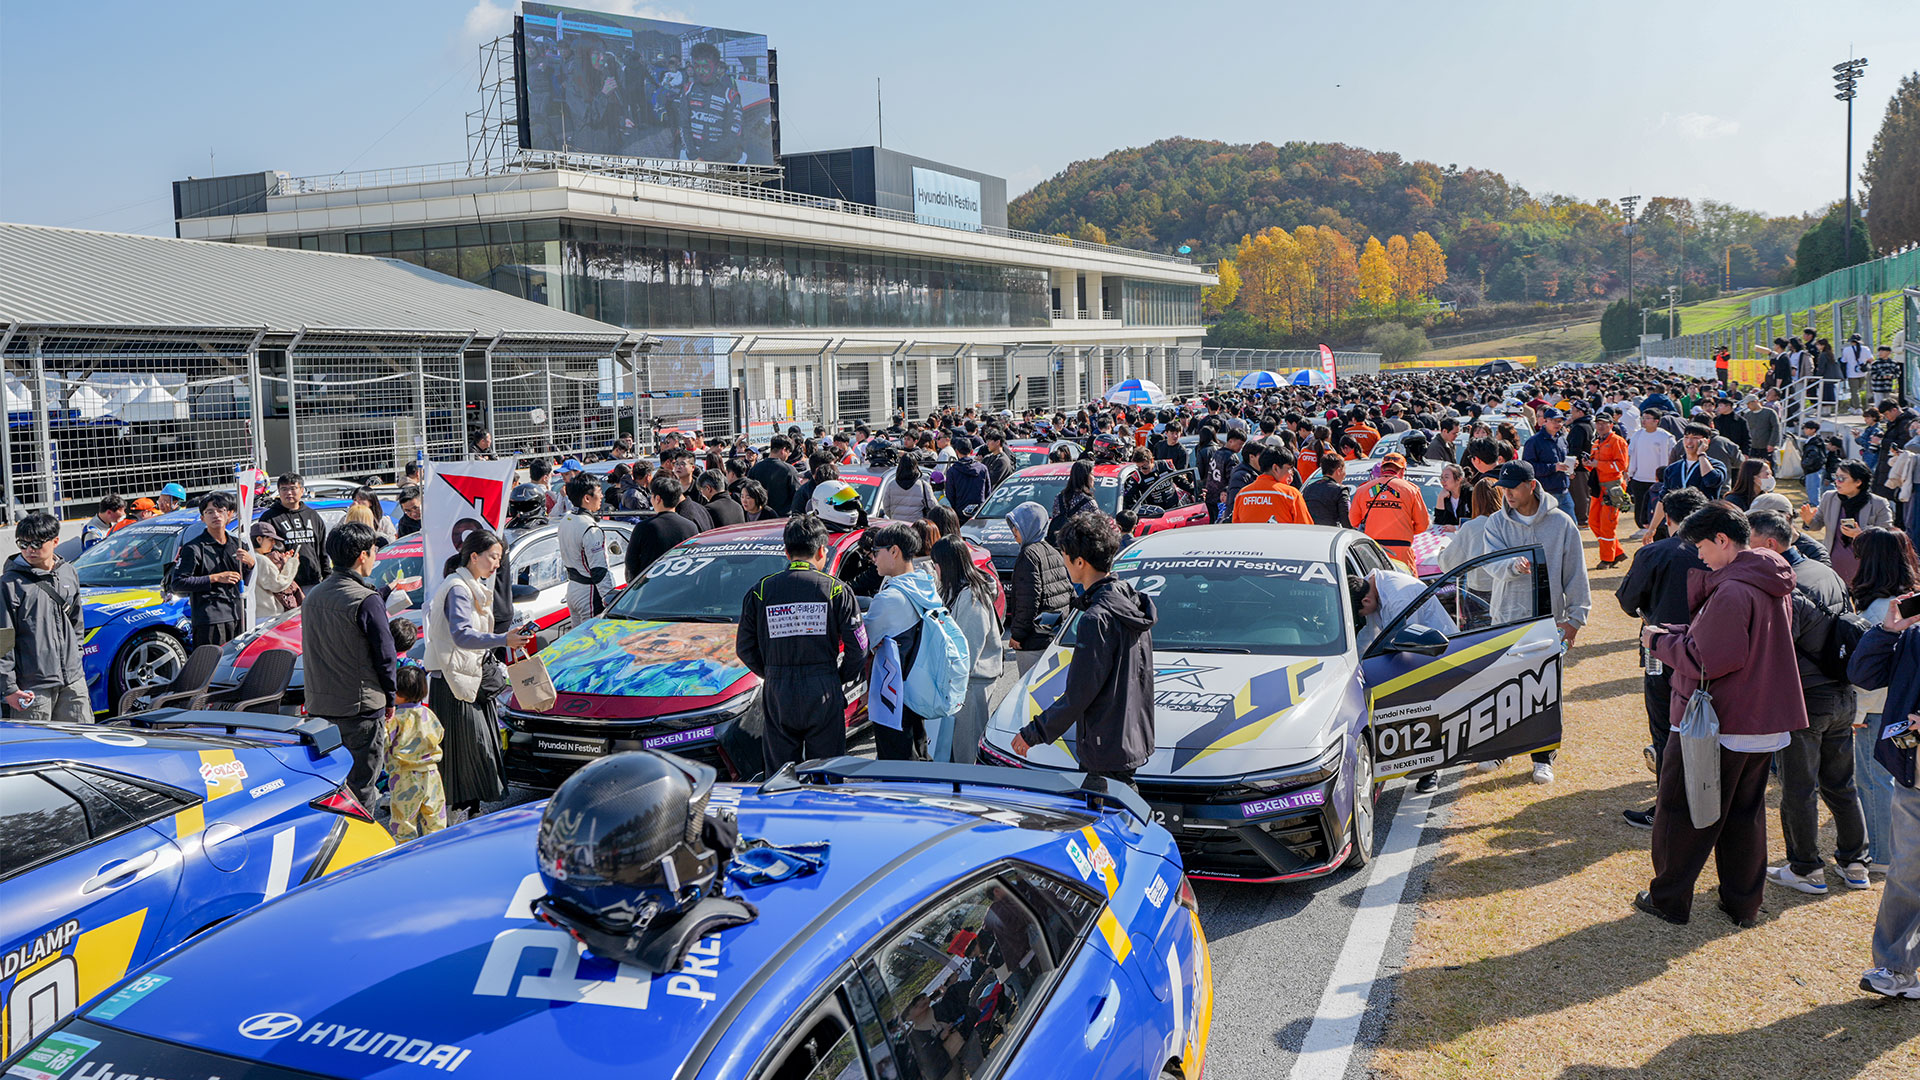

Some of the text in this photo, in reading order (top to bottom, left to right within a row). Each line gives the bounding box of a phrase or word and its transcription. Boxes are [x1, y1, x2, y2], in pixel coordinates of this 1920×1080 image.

[917, 187, 979, 212] Hyundai N Festival
[1374, 445, 1398, 456] 01
[1020, 476, 1057, 484] Hyundai
[1100, 476, 1119, 488] B
[1424, 476, 1444, 487] A
[993, 484, 1035, 499] 072
[1242, 496, 1273, 506] OFFICIAL
[684, 544, 740, 555] Hyundai
[739, 543, 752, 551] N
[646, 557, 716, 579] 097
[1142, 559, 1304, 574] Hyundai N Festival
[1299, 562, 1338, 584] A
[124, 608, 166, 624] Komtec
[767, 605, 796, 617] HSMC
[1375, 705, 1432, 721] yundai N Festival
[1441, 658, 1559, 761] TEAM
[645, 728, 713, 748] NEXEN TIRE
[1378, 722, 1432, 756] 012
[538, 740, 602, 753] Hyundai N Festival
[1393, 758, 1418, 770] NEXEN
[1419, 755, 1435, 764] TIRE
[1244, 792, 1323, 815] NEXEN TIRE
[1201, 870, 1241, 878] Performance
[297, 1021, 472, 1073] HYUNDAI
[45, 1052, 75, 1071] R6
